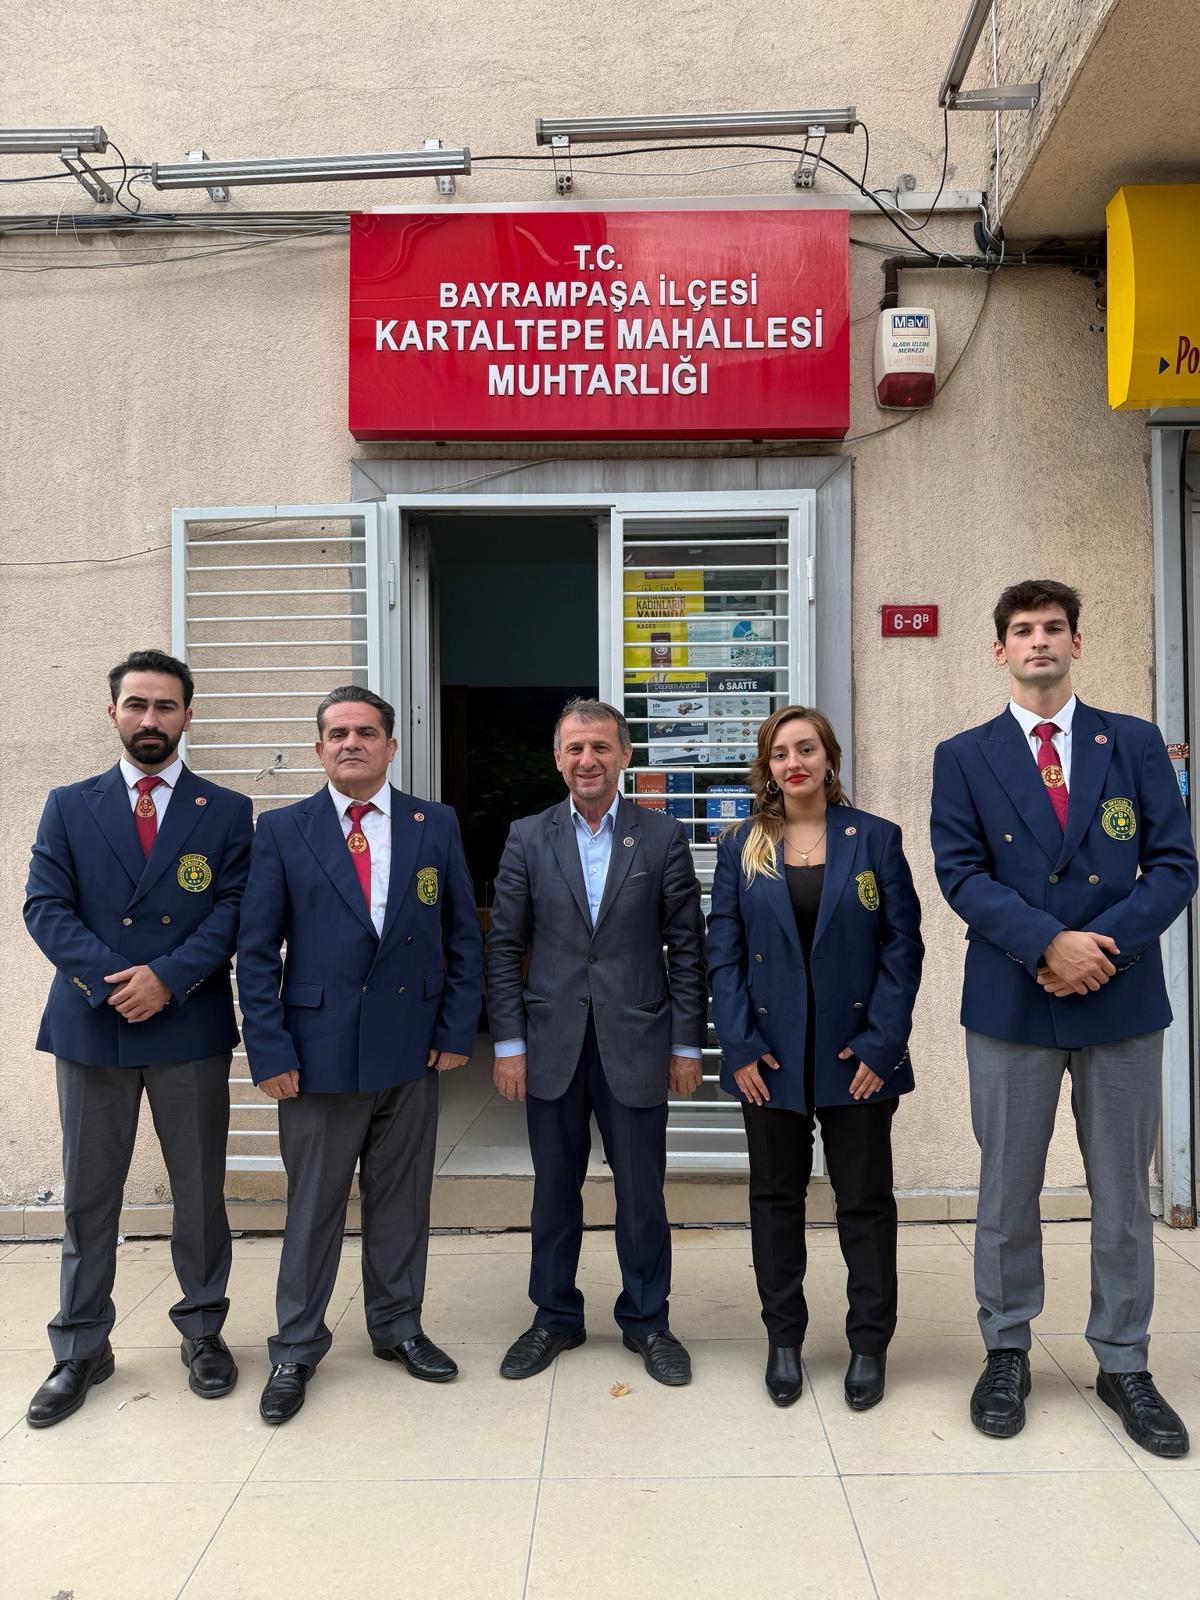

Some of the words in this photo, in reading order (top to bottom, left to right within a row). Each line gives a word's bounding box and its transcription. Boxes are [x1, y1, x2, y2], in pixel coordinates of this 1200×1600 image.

[573, 243, 622, 271] T.C.
[439, 281, 650, 313] BAYRAMPAŞA
[659, 273, 758, 311] İLÇESİ
[375, 319, 605, 351] KARTALTEPE
[616, 309, 823, 350] MAHALLESİ
[894, 315, 929, 329] Mavi
[1175, 336, 1200, 375] Po
[488, 355, 708, 396] MUHTARLIĞI
[636, 599, 686, 610] KADINLARIN
[719, 682, 725, 691] 6
[726, 680, 758, 691] SAATTE
